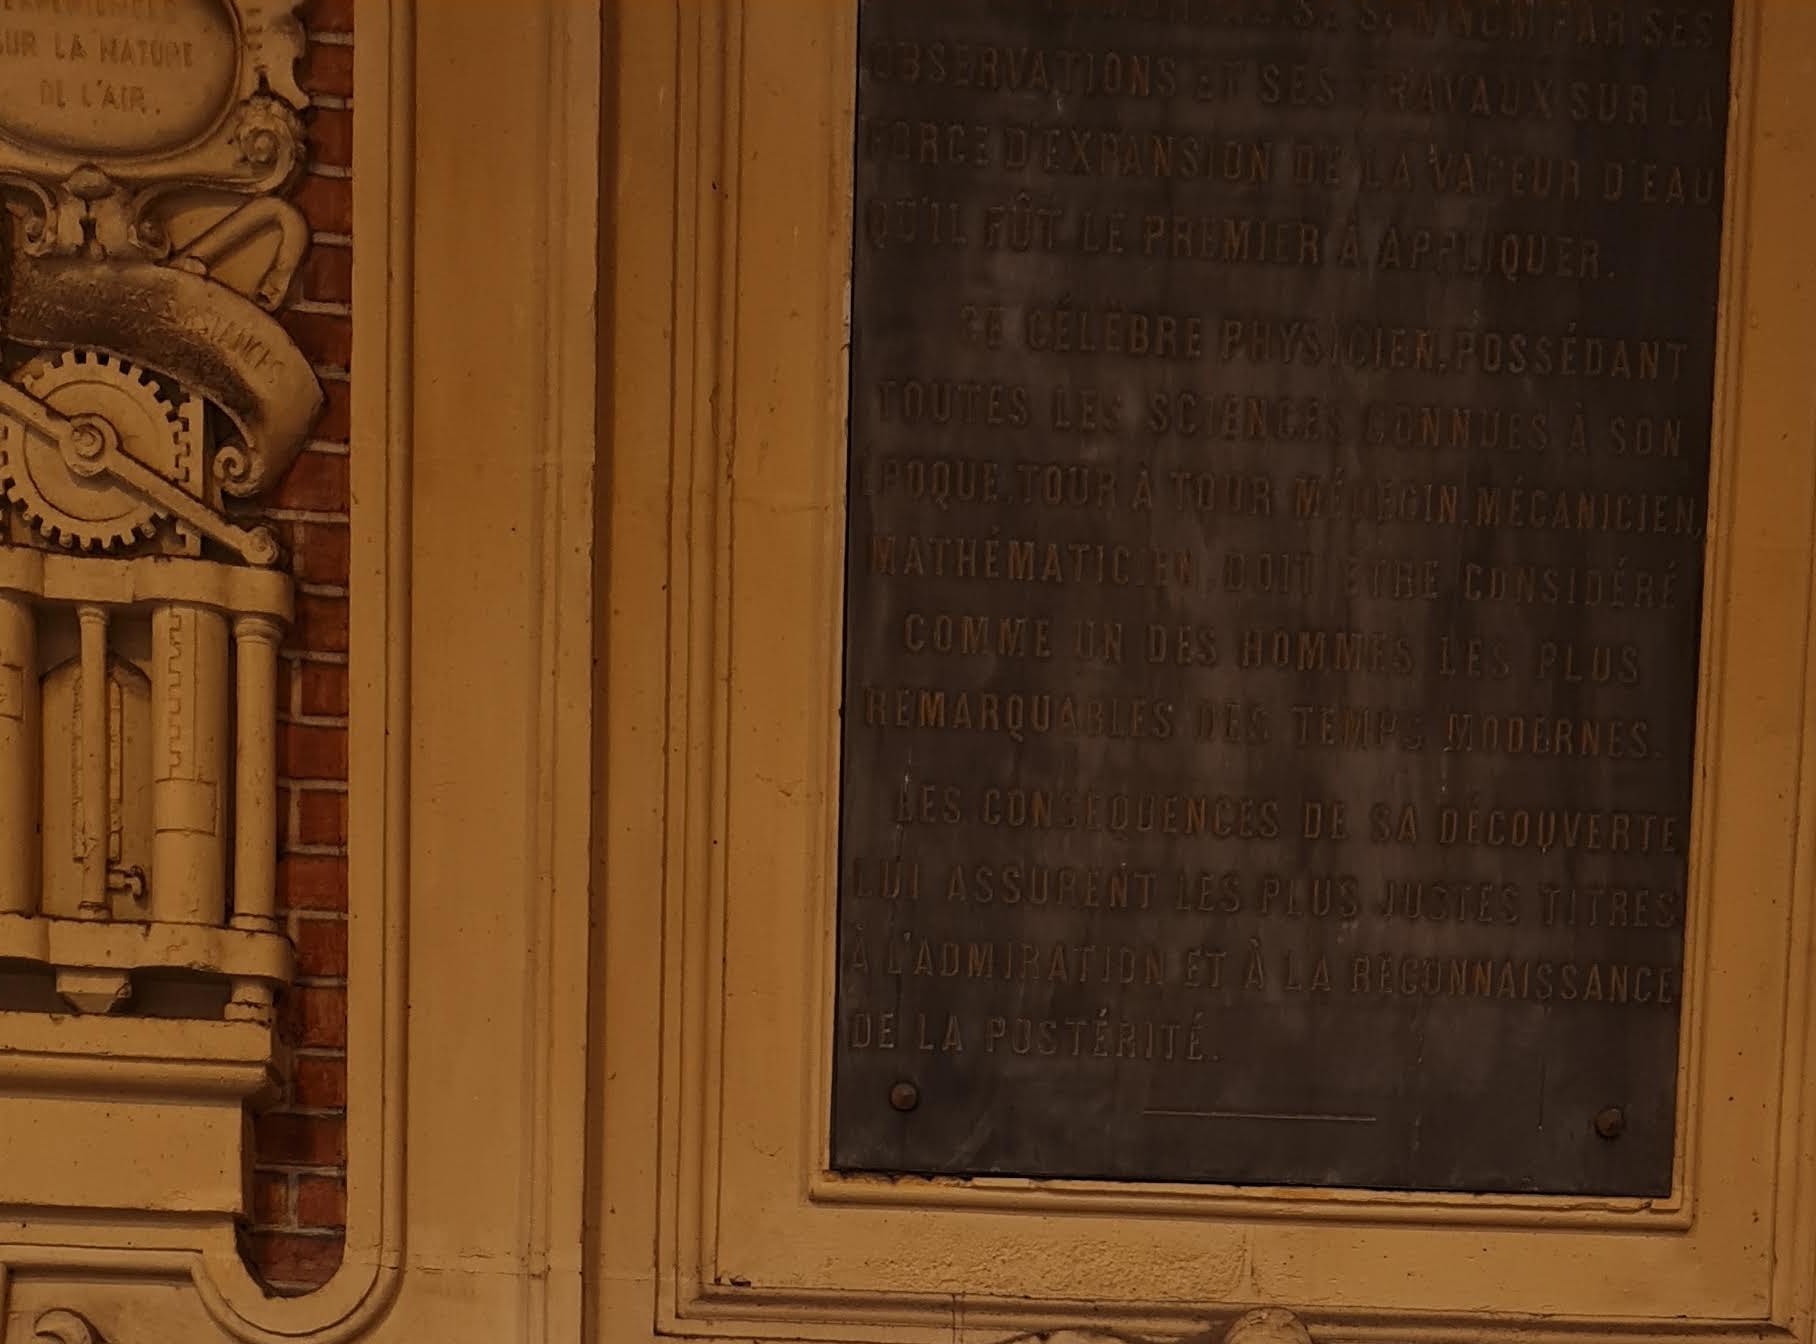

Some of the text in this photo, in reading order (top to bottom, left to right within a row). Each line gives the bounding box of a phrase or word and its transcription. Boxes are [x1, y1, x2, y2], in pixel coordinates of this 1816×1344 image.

[54, 31, 88, 61] LA
[99, 33, 193, 67] NATURE
[1638, 9, 1713, 49] SES
[870, 40, 1176, 97] OBSERVATIONS
[1257, 63, 1336, 106] SES
[1567, 80, 1651, 125] SUR
[1665, 86, 1715, 128] LA
[867, 117, 991, 168] FORCE
[1003, 129, 1272, 184] D'EXPANSION
[1078, 211, 1127, 253] LE
[1144, 215, 1321, 266] PREMIER
[1455, 321, 1690, 384] POSSÉDANT
[877, 379, 1031, 430] TOUTES
[1052, 390, 1124, 434] LES
[1149, 391, 1346, 444] SCIENCES
[1366, 402, 1549, 453] CONNUES
[1611, 415, 1682, 458] SON
[1017, 461, 1119, 513] TOUR
[1169, 470, 1272, 518] TOUR
[903, 611, 1643, 688] COMME UN DES HOMMES LES PLUS
[863, 688, 1177, 743] REMARQUABLES
[1303, 799, 1347, 841] DE
[1368, 801, 1419, 845] SA
[1437, 799, 1680, 853] DÉCOUVERTE
[947, 862, 1156, 913] ASSURENT
[1174, 869, 1243, 915] LES
[1254, 873, 1360, 923] PLUS
[1376, 877, 1520, 928] JUSTES
[888, 932, 1166, 984] L'ADMIRATION
[1183, 945, 1229, 989] ET
[1246, 934, 1268, 992] À
[1284, 949, 1333, 993] LA
[1350, 951, 1679, 1005] RECONNAISSANCE
[852, 1008, 897, 1050] DE
[916, 1012, 965, 1054] LA
